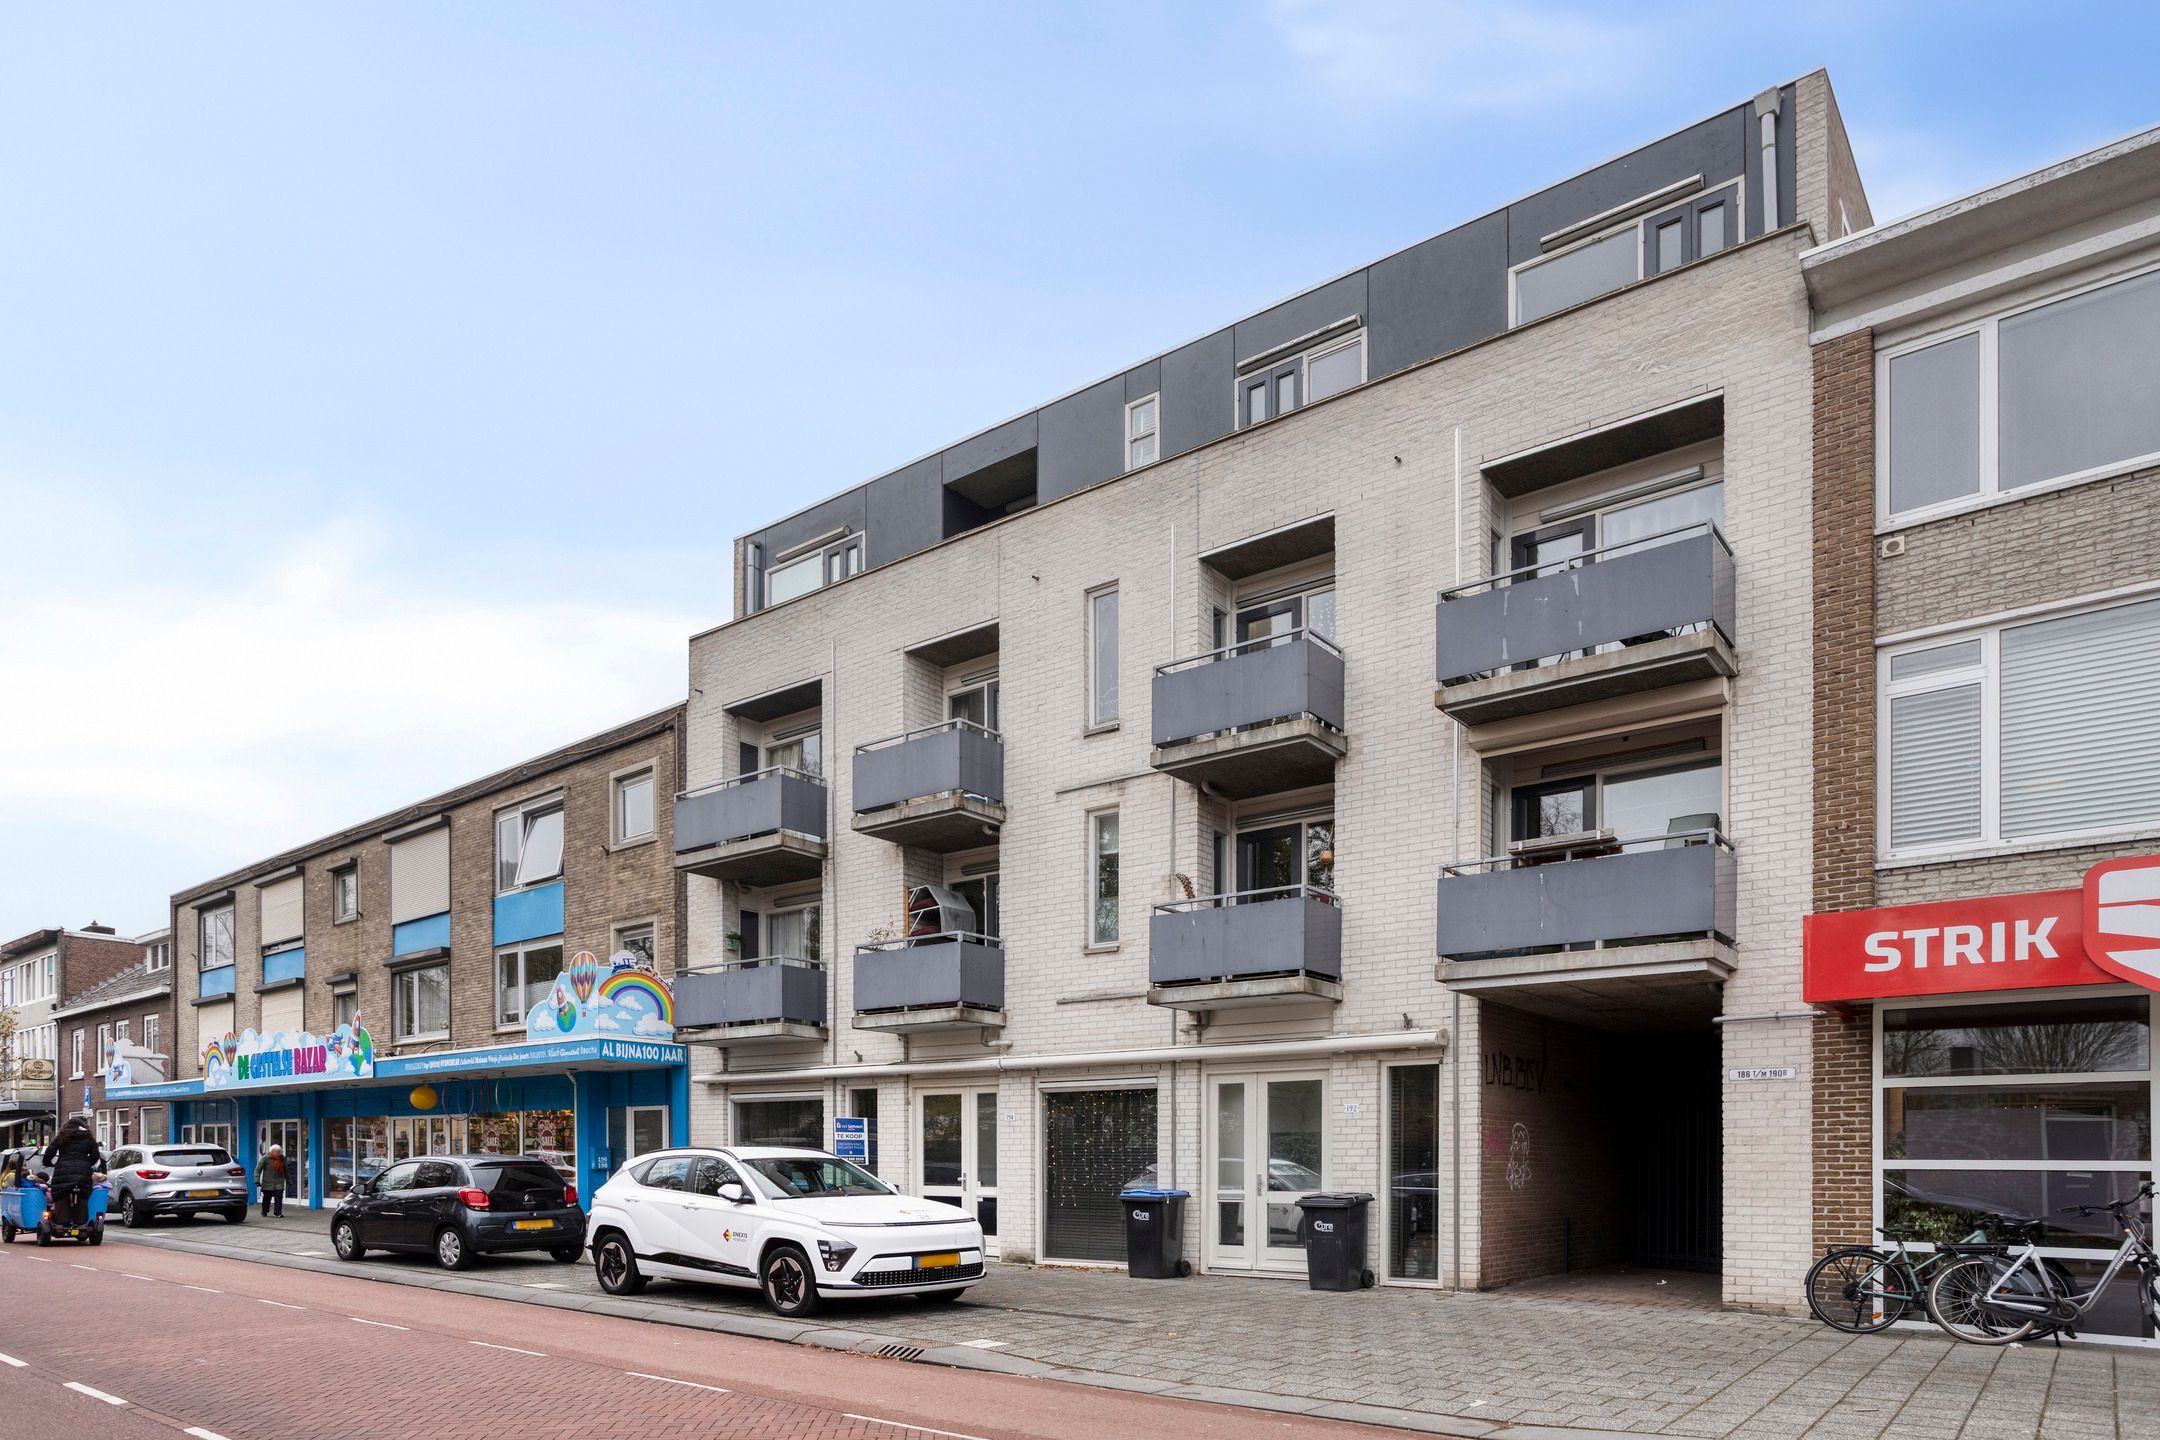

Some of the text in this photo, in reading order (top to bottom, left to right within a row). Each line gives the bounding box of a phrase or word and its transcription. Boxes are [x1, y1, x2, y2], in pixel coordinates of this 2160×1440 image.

[1864, 916, 2060, 972] STRIK
[602, 1041, 614, 1057] AL
[237, 1045, 327, 1080] DE GESTELSE BAZAR
[1737, 1070, 1750, 1078] 186
[1753, 1070, 1767, 1078] T/M
[486, 1136, 498, 1146] SALE
[542, 1135, 555, 1145] SALE
[433, 1145, 447, 1156] SALE
